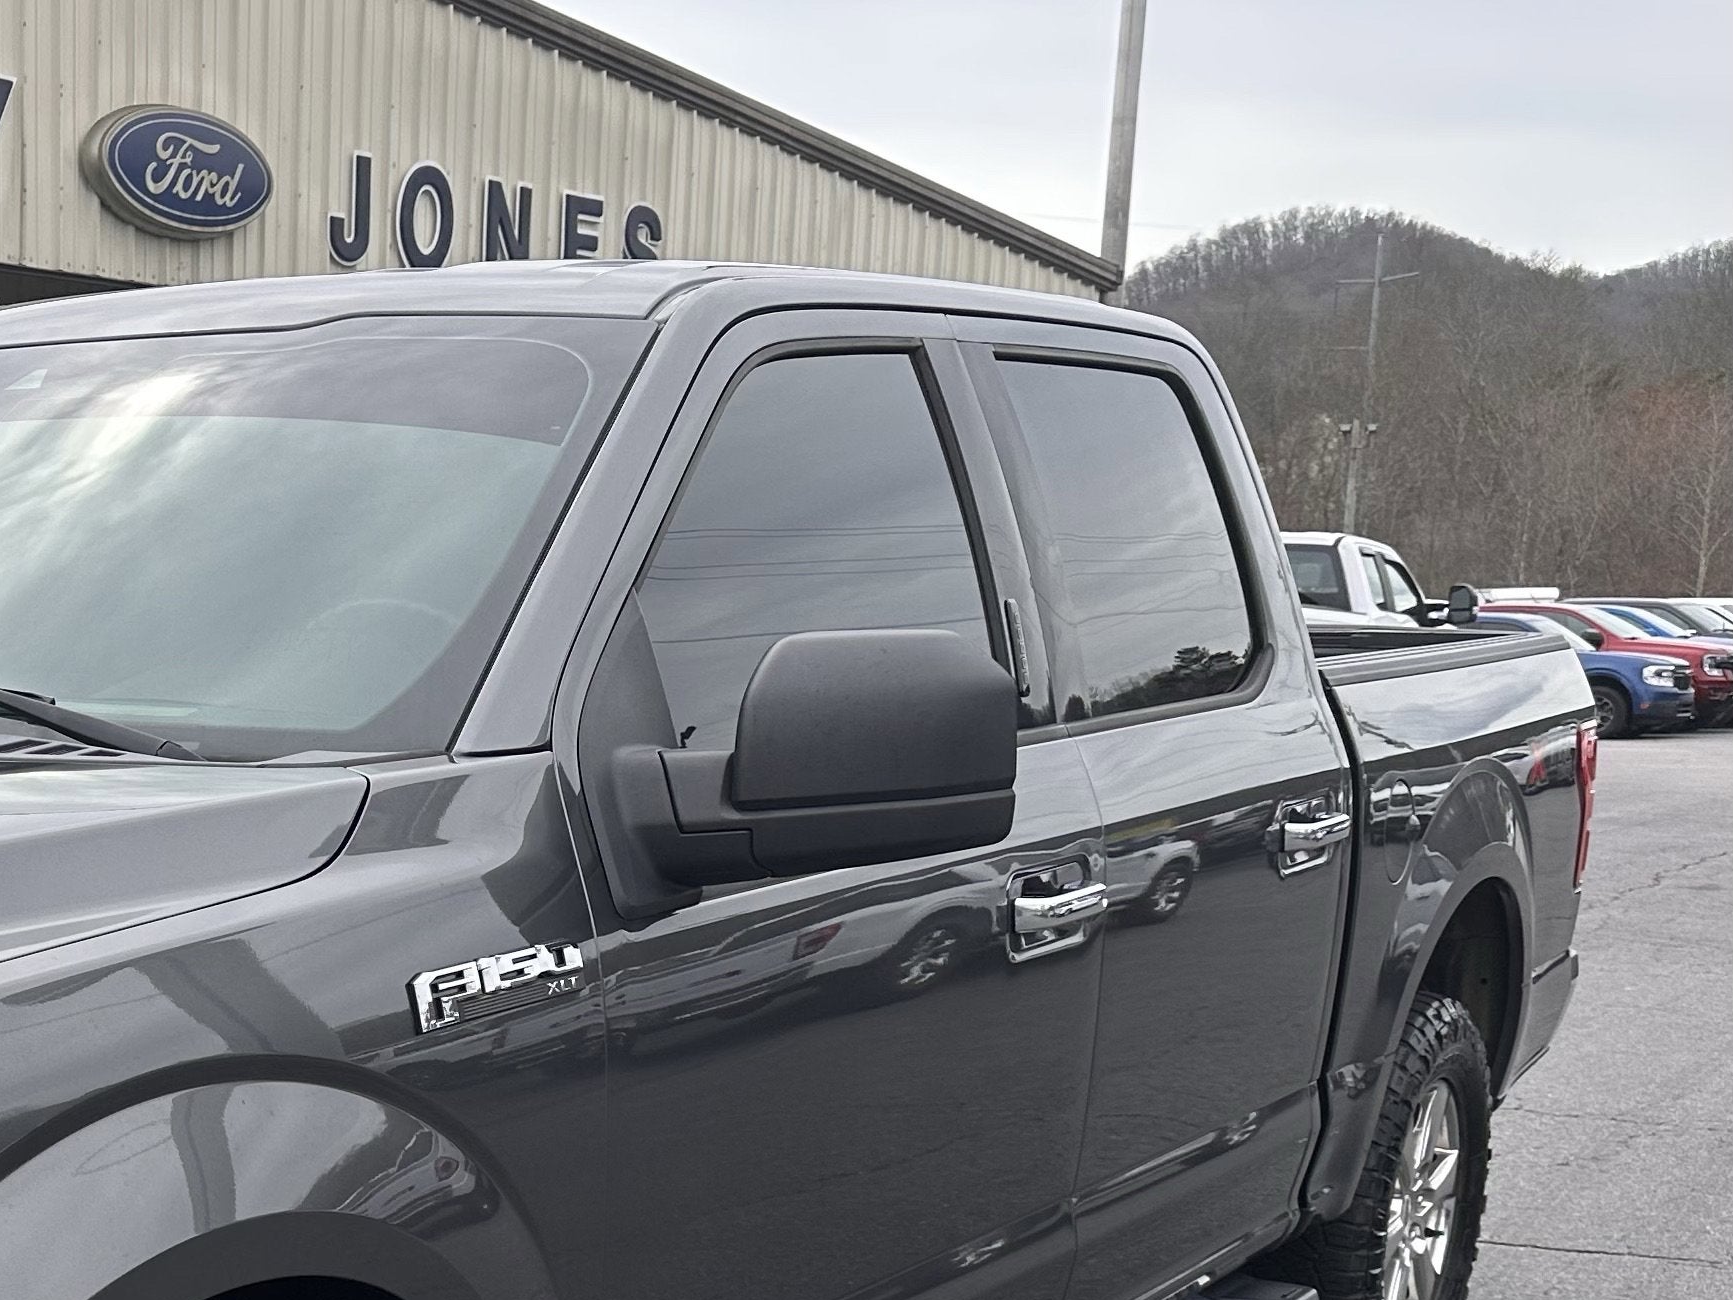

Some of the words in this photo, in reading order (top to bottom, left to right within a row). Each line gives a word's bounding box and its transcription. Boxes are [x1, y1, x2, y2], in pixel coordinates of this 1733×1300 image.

[145, 131, 245, 208] Ford
[326, 150, 663, 267] JONES
[547, 974, 579, 996] XLT
